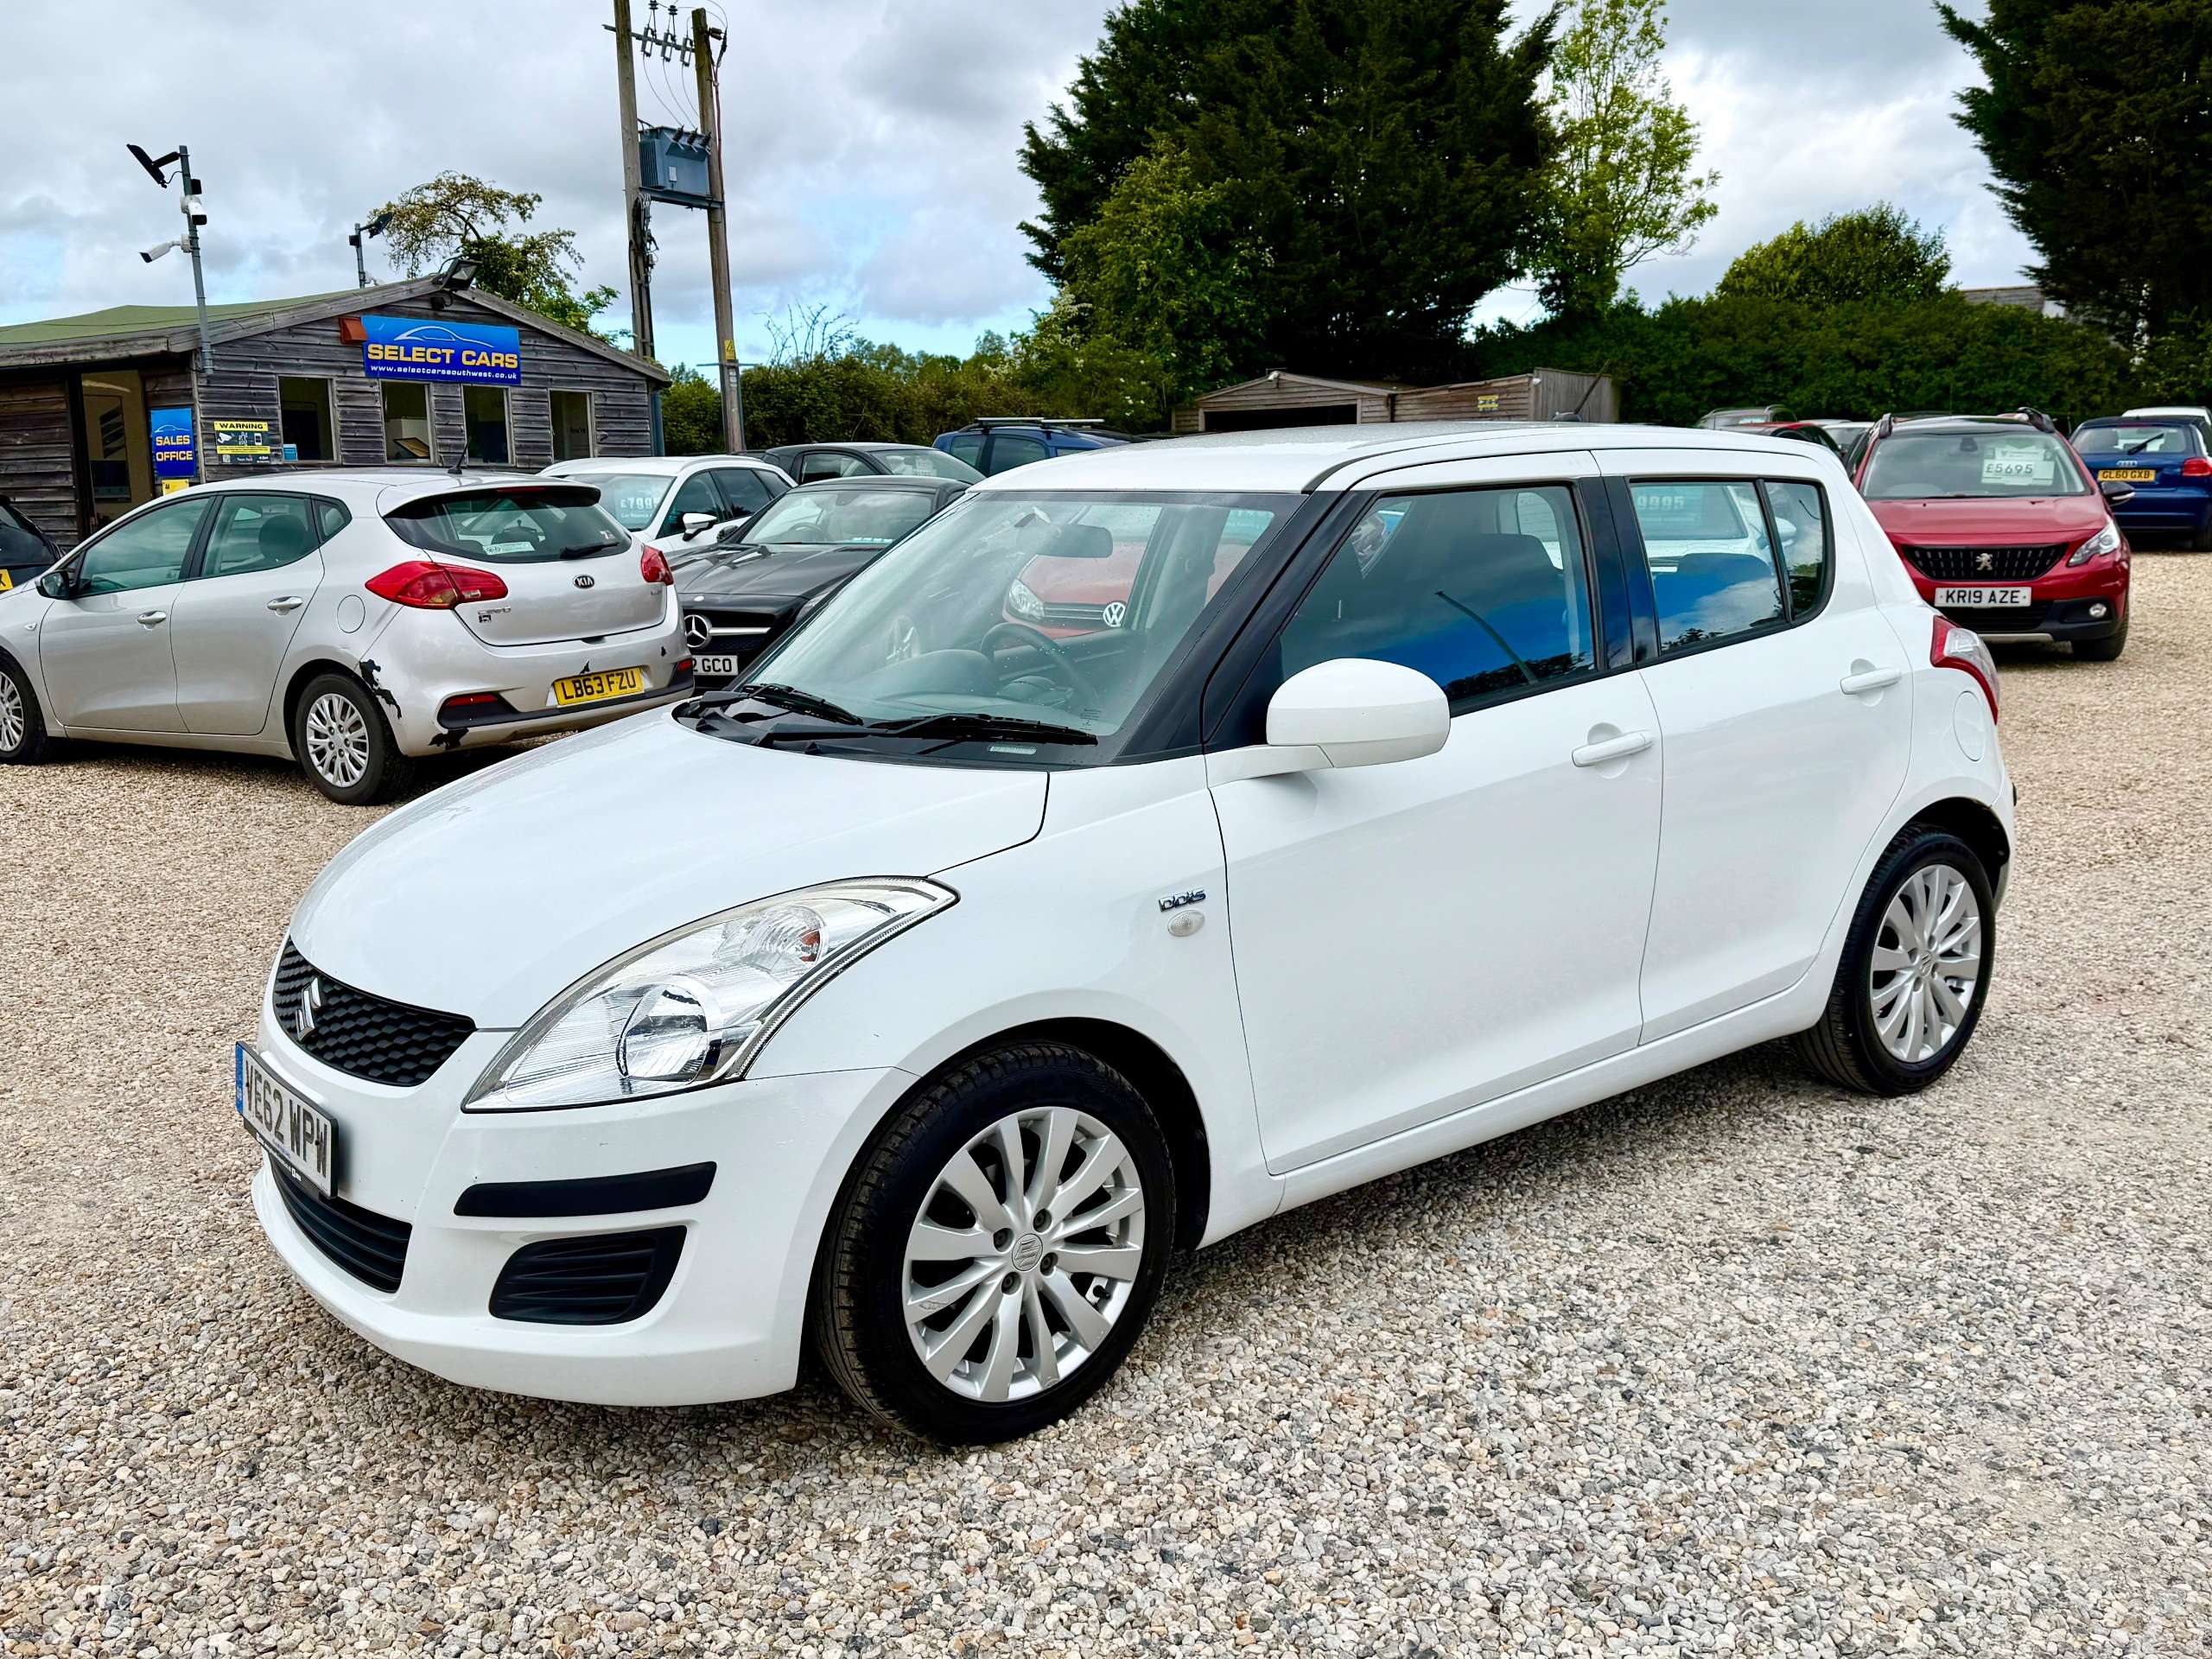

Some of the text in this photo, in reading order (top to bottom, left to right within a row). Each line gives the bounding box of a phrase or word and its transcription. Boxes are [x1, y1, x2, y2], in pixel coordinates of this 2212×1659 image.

[367, 344, 518, 369] SELECT CARS
[370, 365, 518, 379] www.selectcarssouthwest.co.uk
[156, 435, 191, 446] SALES
[156, 451, 194, 462] OFFICE
[1986, 463, 2033, 474] £5695
[2102, 470, 2128, 479] GL60
[576, 577, 594, 586] KIA
[1945, 589, 2020, 603] KR19 AZE
[702, 658, 733, 673] GCO
[561, 671, 637, 700] LB63 FZU
[245, 1060, 284, 1144] VE62
[289, 1098, 327, 1179] WPW
